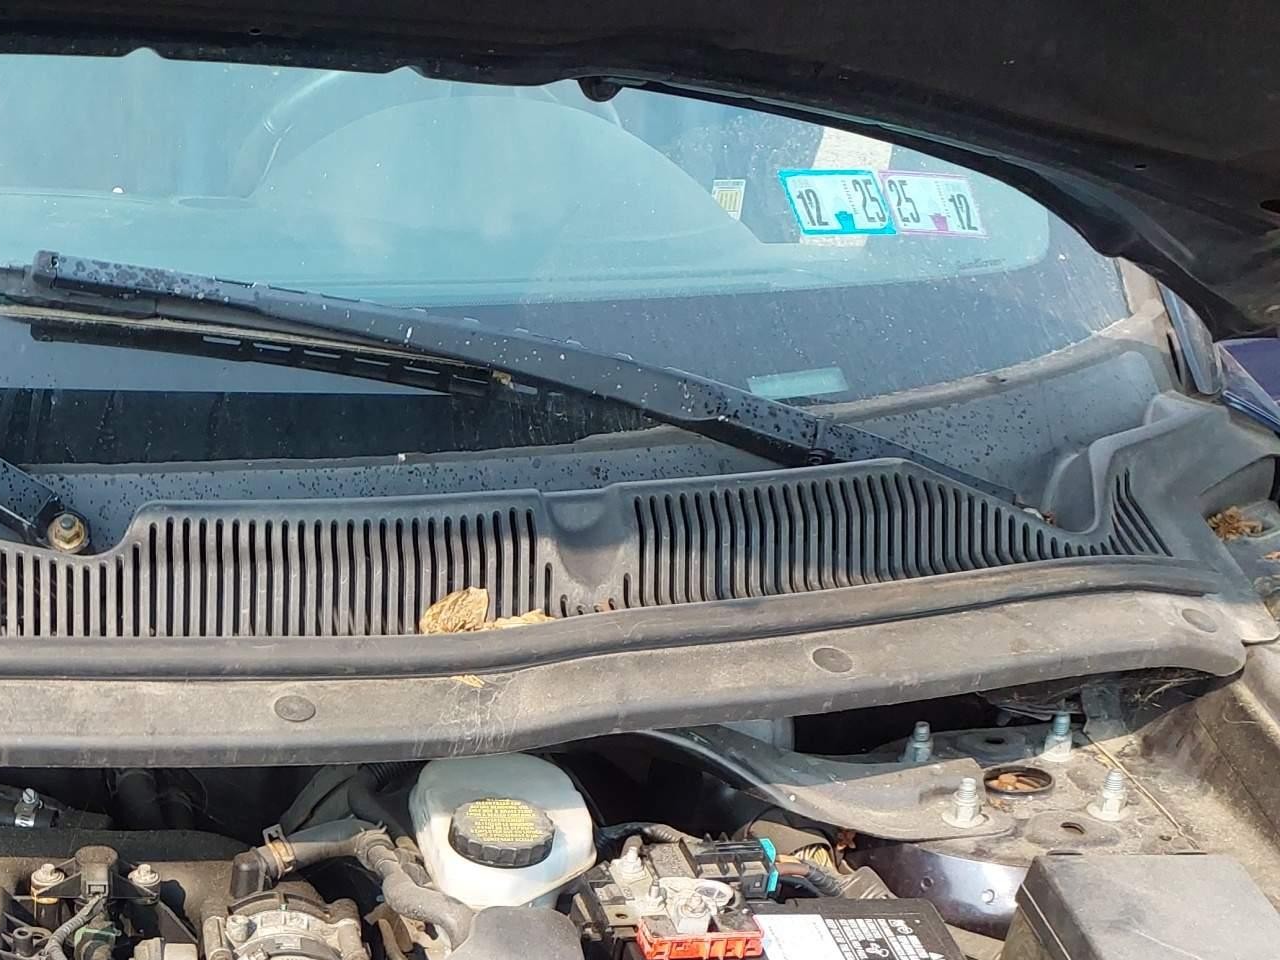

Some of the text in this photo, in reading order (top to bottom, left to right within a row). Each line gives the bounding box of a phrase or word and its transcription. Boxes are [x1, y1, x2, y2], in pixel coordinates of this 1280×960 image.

[796, 188, 830, 227] 12
[852, 179, 886, 222] 25
[888, 179, 920, 223] 25
[949, 193, 979, 231] 12
